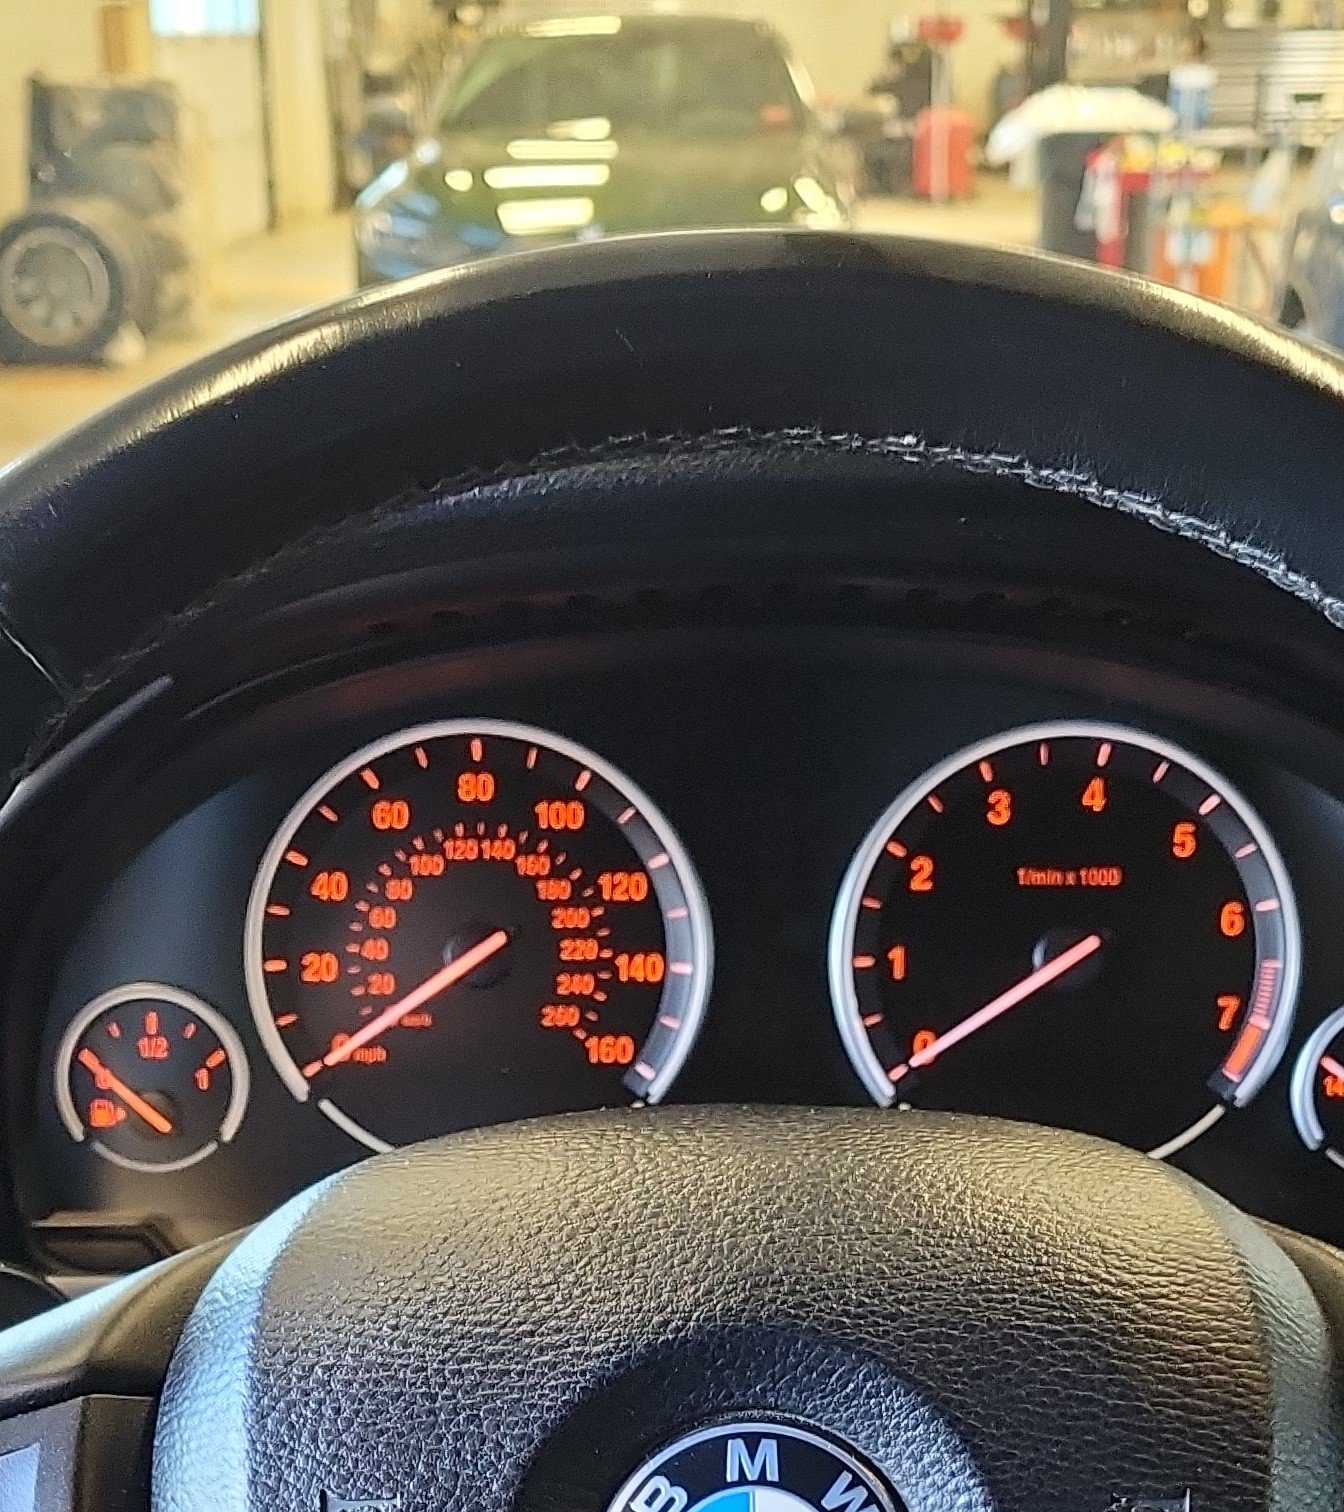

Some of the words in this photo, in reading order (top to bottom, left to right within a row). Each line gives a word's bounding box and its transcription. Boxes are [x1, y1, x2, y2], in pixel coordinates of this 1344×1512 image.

[457, 772, 495, 802] 80
[1081, 776, 1106, 812] 4
[372, 801, 410, 829] 60
[535, 801, 585, 829] 100
[986, 789, 1012, 826] 3
[443, 838, 478, 860] 120
[480, 838, 516, 860] 140
[1172, 822, 1197, 859] 5
[310, 872, 349, 901] 40
[597, 872, 648, 901] 120
[909, 856, 934, 892] 2
[1017, 867, 1064, 886] 1/min
[1079, 867, 1122, 886] 1000
[1220, 902, 1245, 937] 6
[300, 953, 339, 982] 20
[615, 953, 665, 982] 140
[887, 945, 906, 981] 1
[1217, 995, 1241, 1031] 7
[585, 1036, 635, 1064] 160
